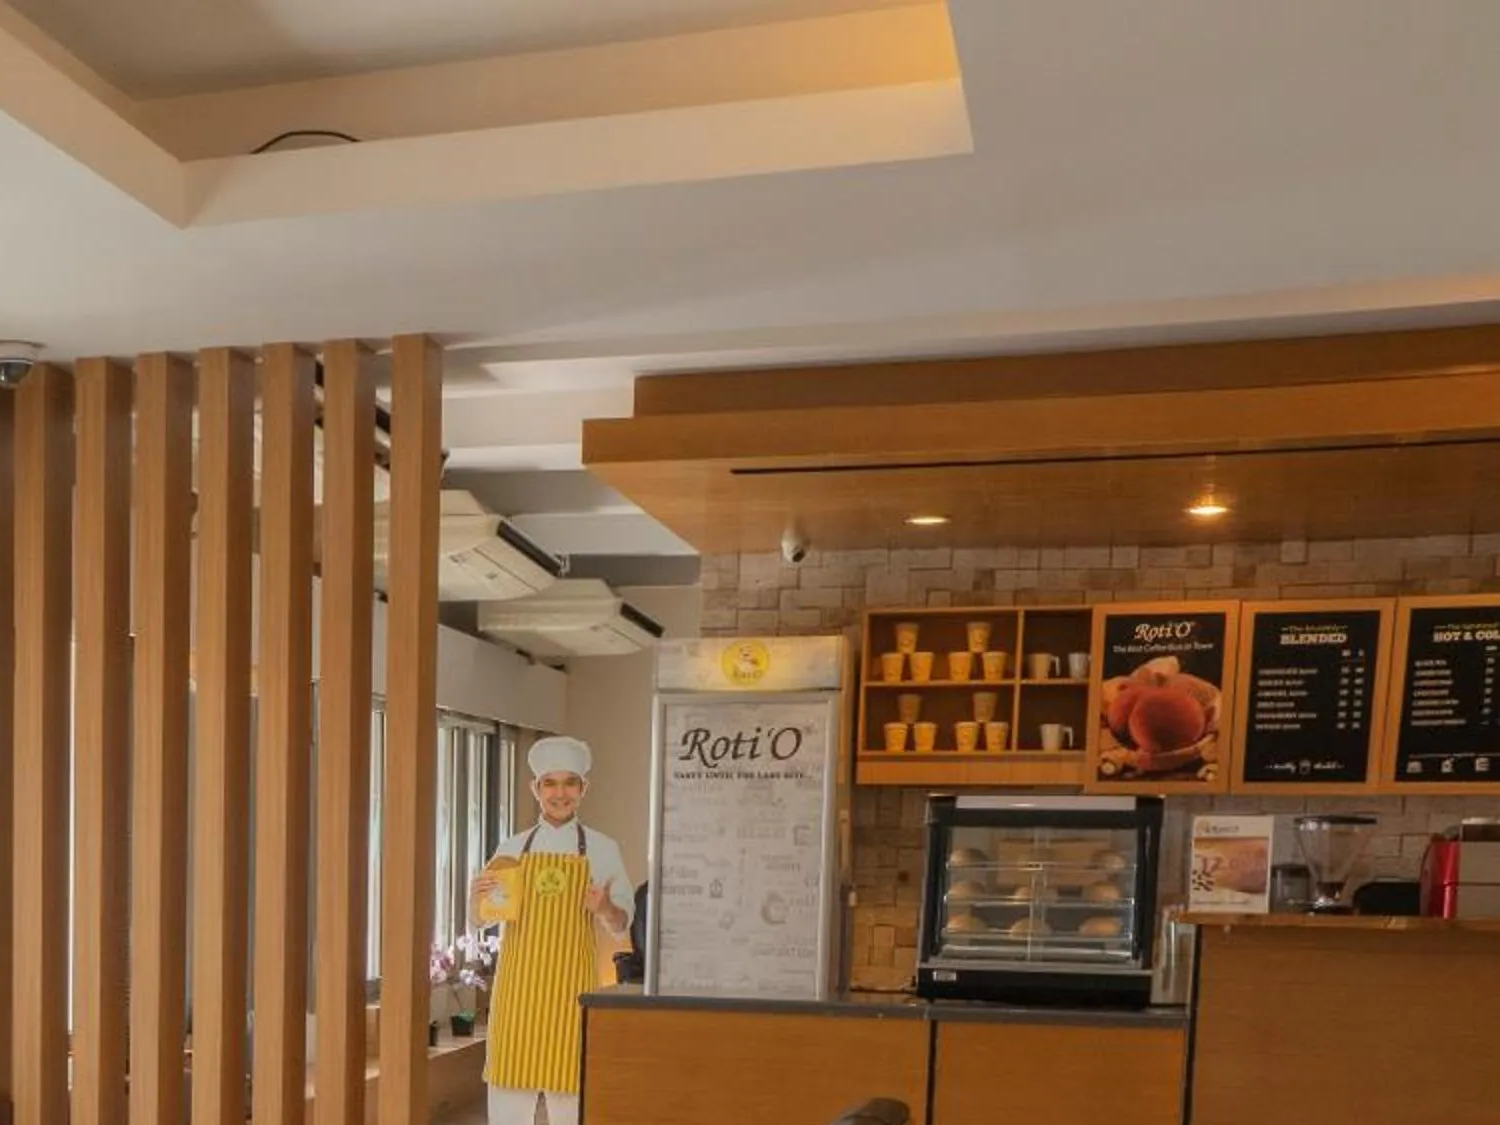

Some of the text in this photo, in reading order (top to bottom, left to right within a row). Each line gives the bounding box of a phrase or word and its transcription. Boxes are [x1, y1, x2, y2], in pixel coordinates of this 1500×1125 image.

[1280, 633, 1348, 645] BLENDED
[1433, 631, 1461, 642] HOT
[1463, 631, 1473, 641] &
